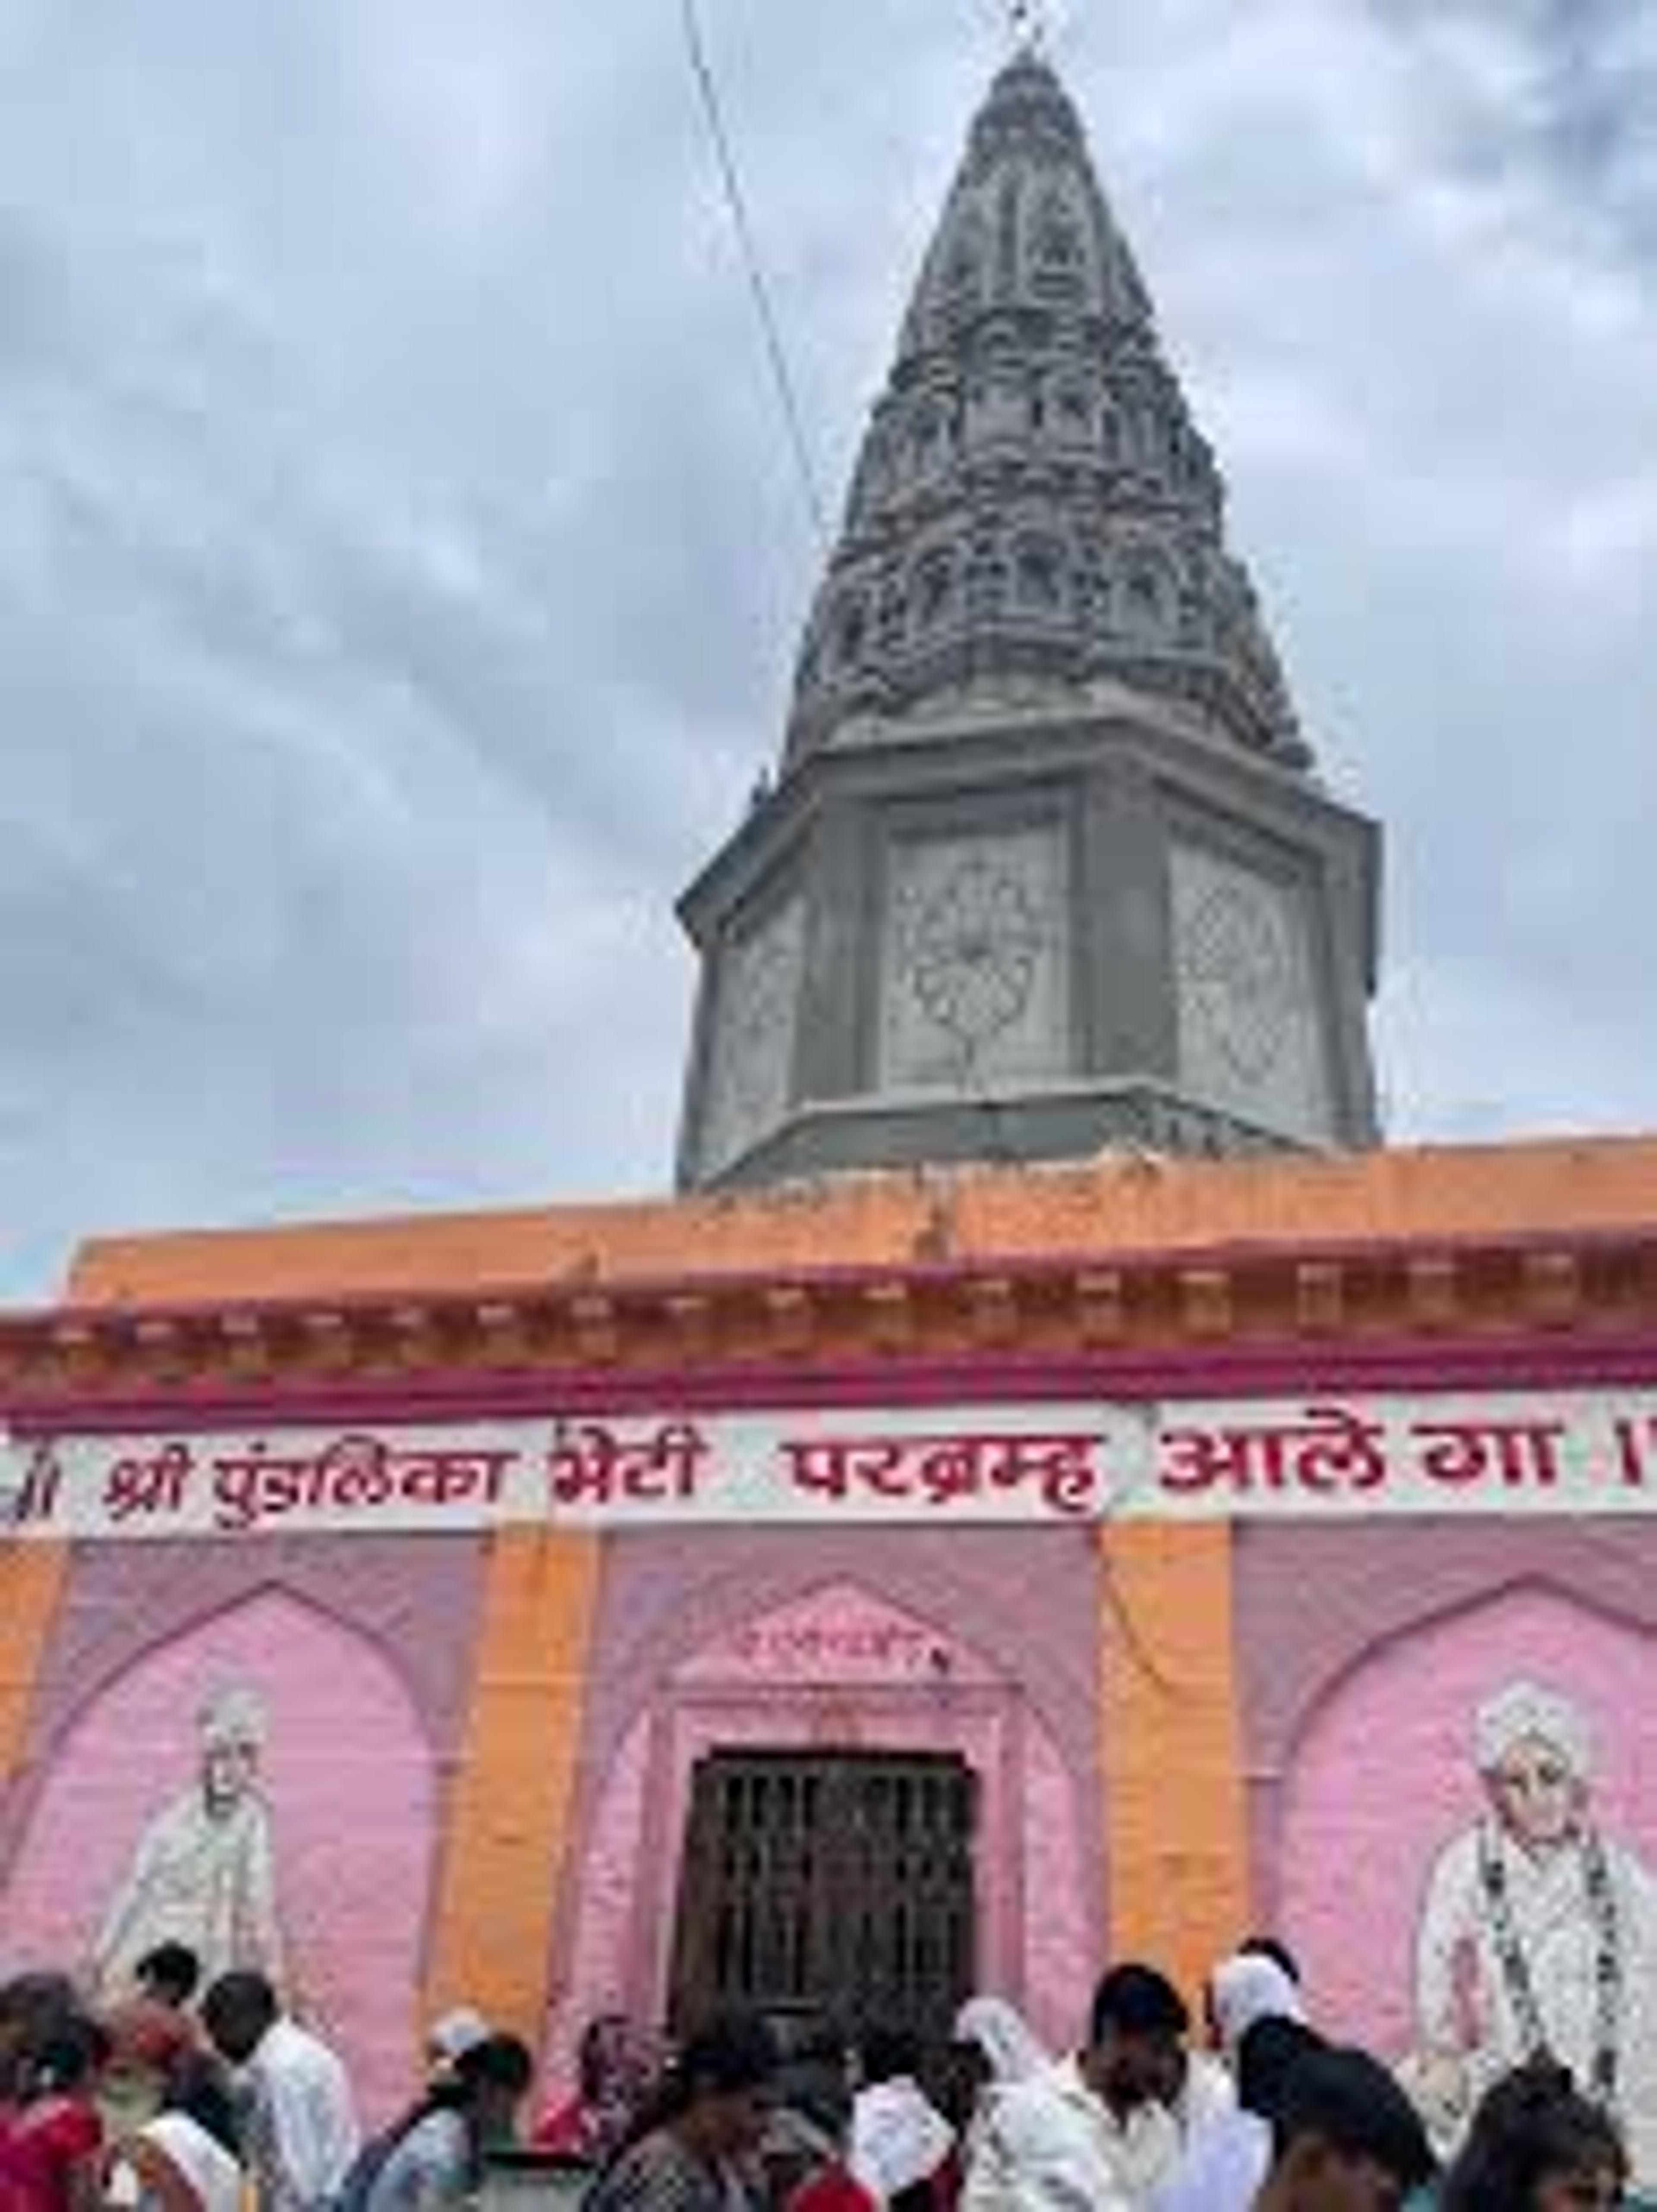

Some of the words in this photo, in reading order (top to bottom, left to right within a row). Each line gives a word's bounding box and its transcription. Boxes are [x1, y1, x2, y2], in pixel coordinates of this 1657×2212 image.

[104, 1442, 194, 1521] श्री
[547, 1425, 709, 1502] भेटी
[1160, 1407, 1386, 1491] आले
[1409, 1424, 1563, 1485] गा
